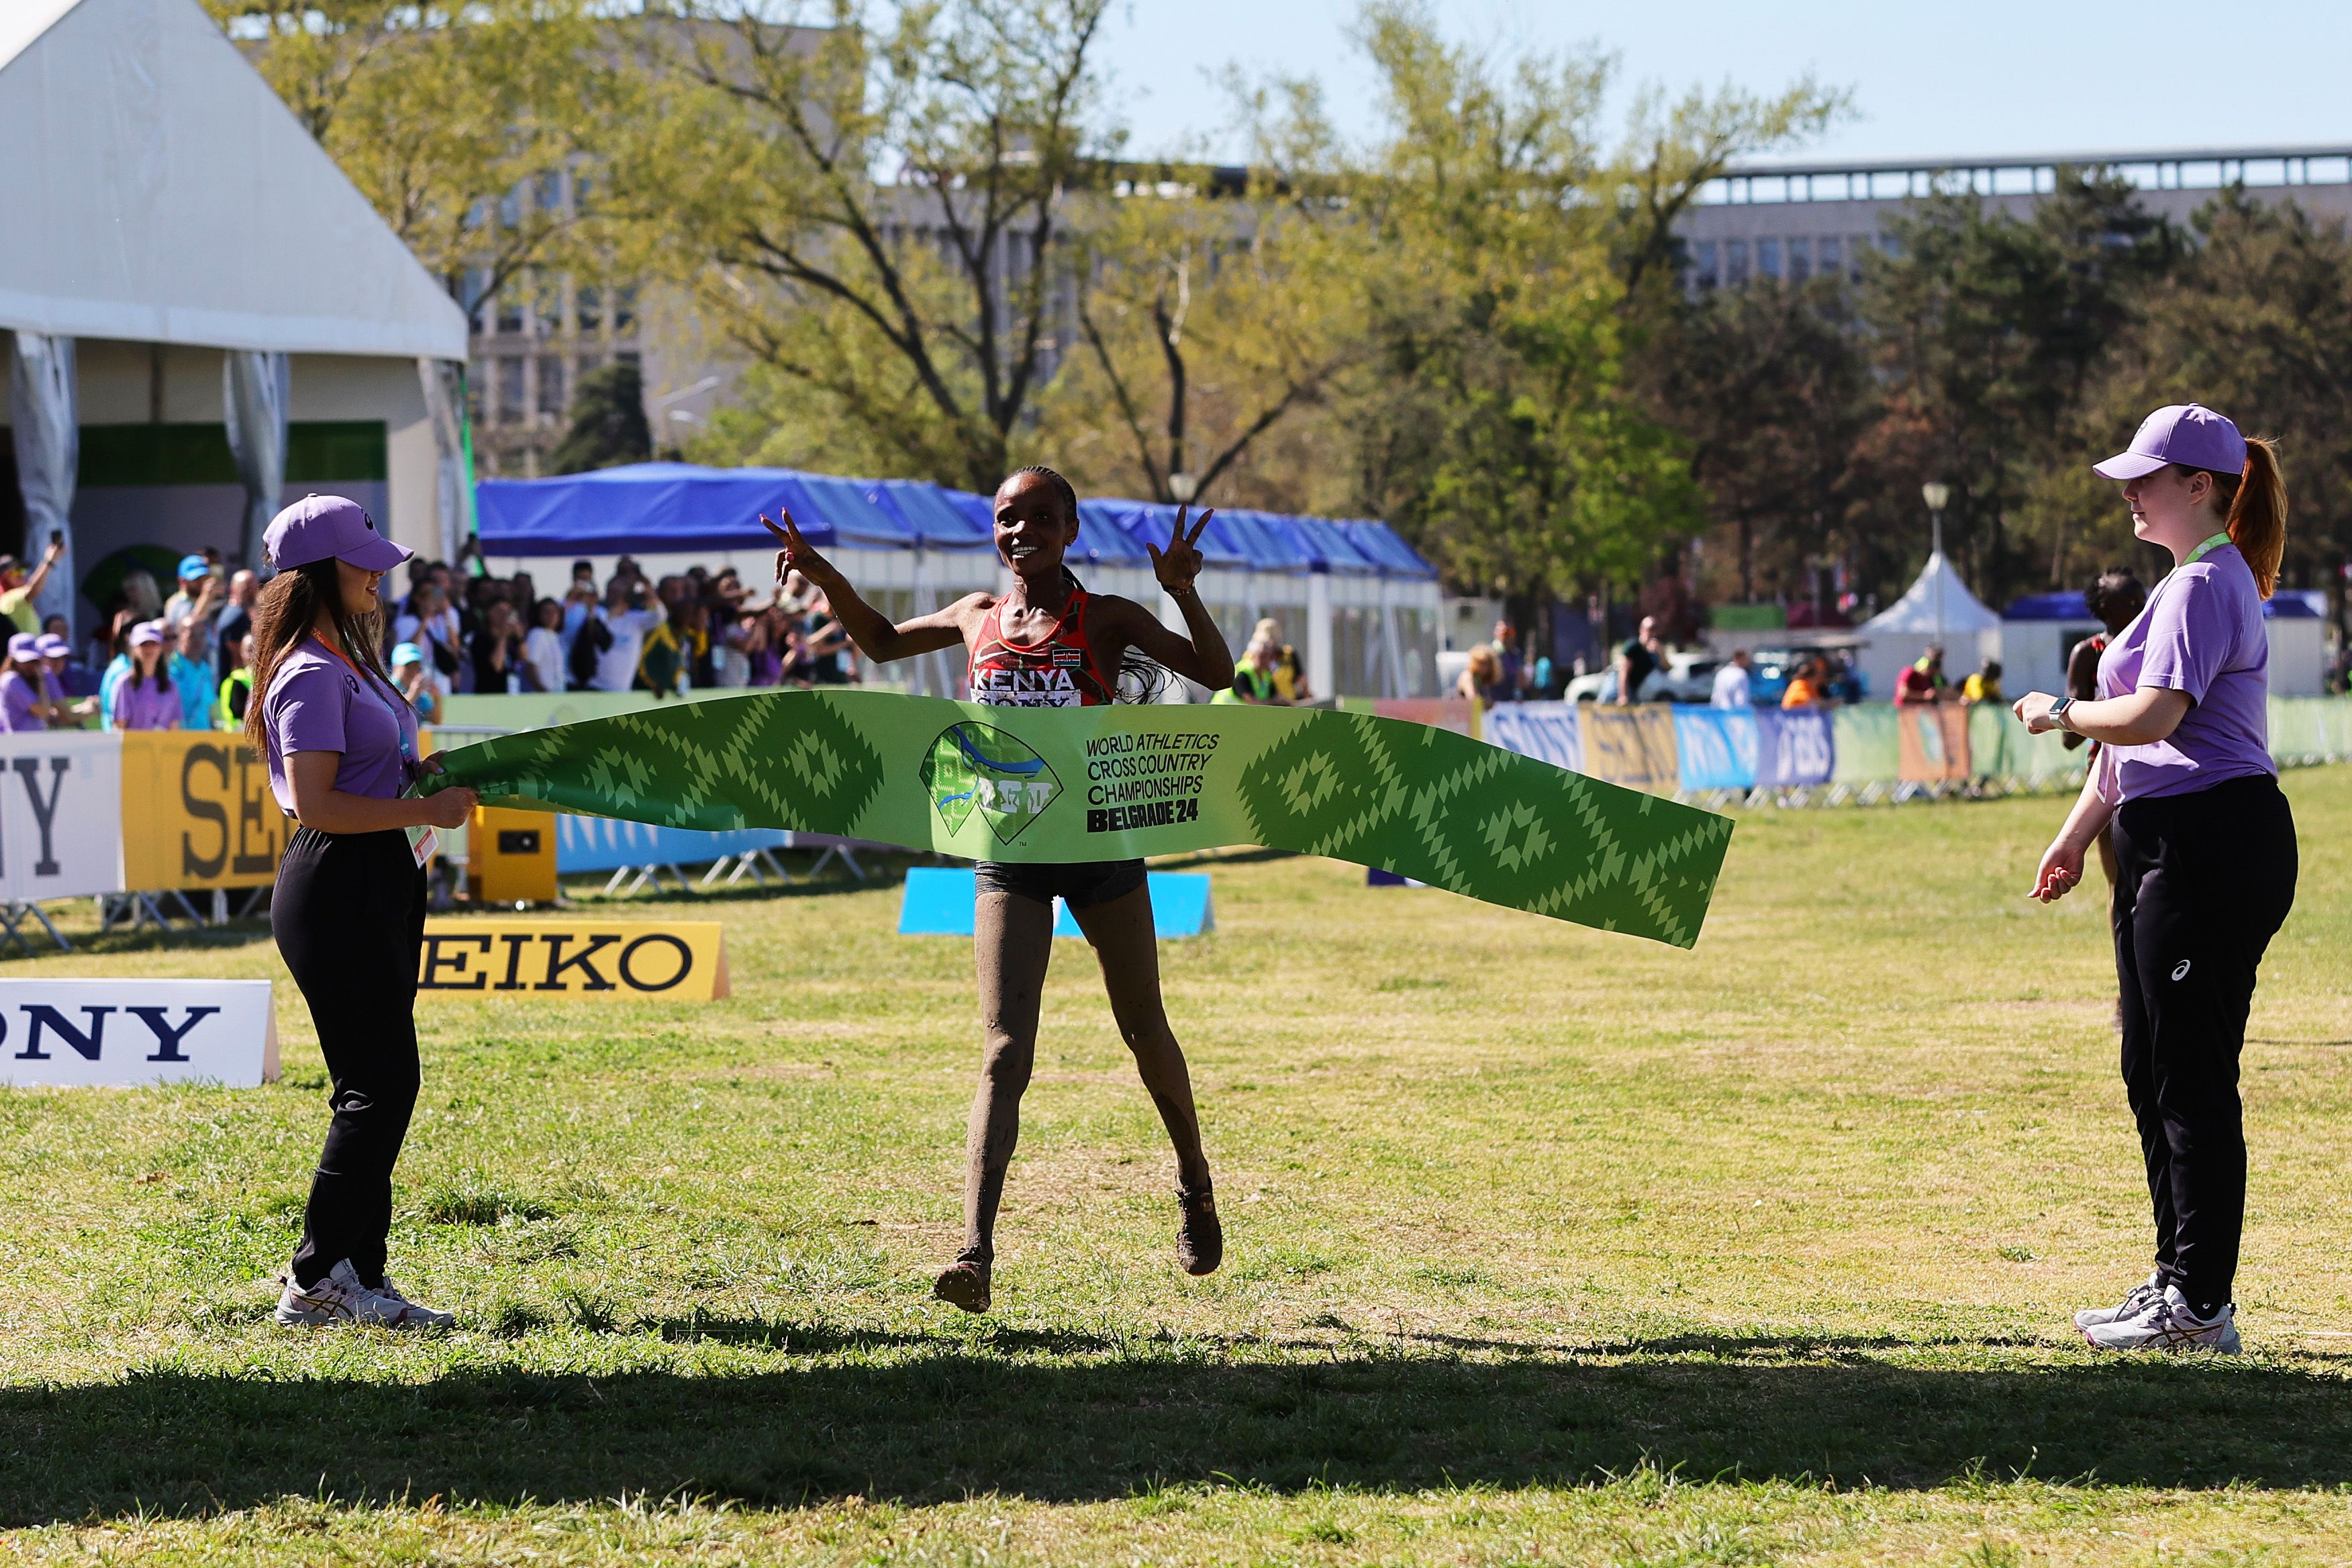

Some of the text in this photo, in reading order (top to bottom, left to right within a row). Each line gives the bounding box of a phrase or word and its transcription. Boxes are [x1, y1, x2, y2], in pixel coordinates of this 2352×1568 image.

[973, 669, 1075, 691] KENYA
[1086, 734, 1220, 757] WORLD ATHLETICS
[1087, 754, 1213, 781] CROSS COUNTRY
[1087, 775, 1204, 805] CHAMPIONSHIPS
[181, 742, 290, 879] SE
[1087, 798, 1199, 832] BELGRADE 24
[0, 1004, 221, 1061] NY
